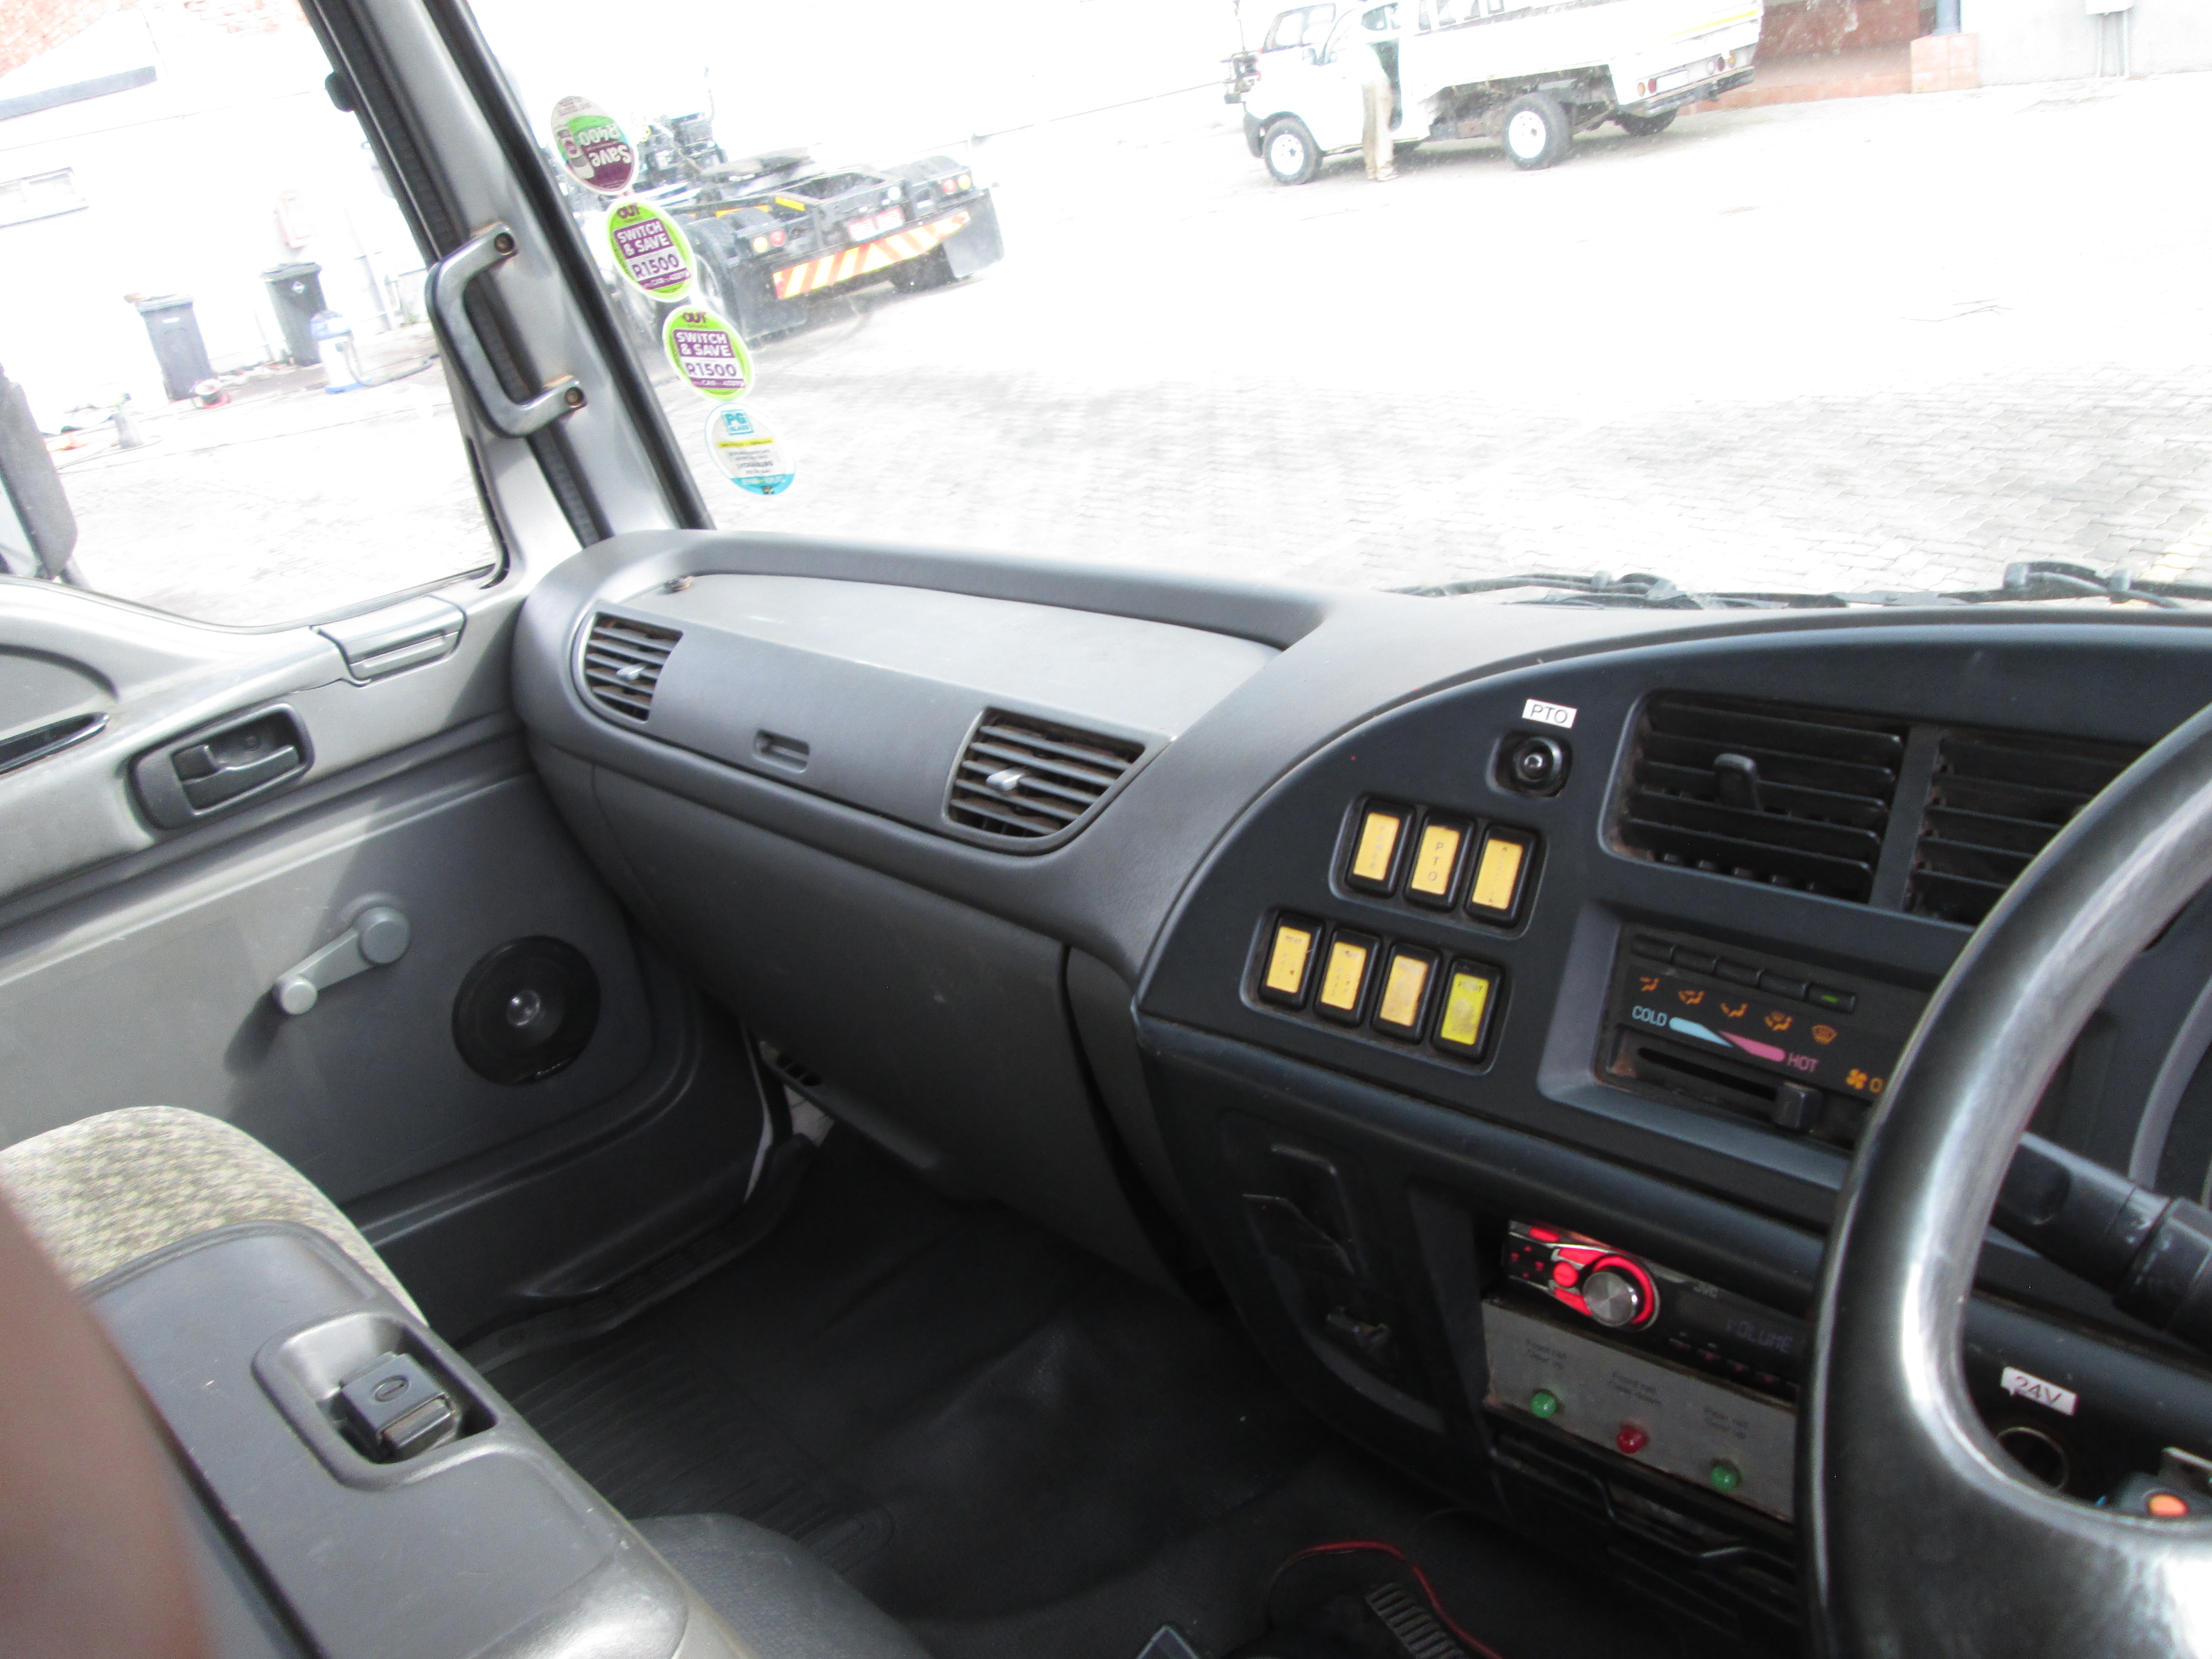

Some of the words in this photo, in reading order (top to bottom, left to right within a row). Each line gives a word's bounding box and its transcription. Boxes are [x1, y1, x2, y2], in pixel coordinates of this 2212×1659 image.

[578, 122, 621, 146] R400
[588, 144, 631, 167] Save
[616, 221, 664, 243] SWITCH
[624, 243, 636, 256] &
[634, 232, 671, 253] SAVE
[631, 254, 679, 278] R1500
[676, 332, 728, 345] SWITCH
[680, 343, 692, 355] &
[693, 344, 732, 357] SAVE
[685, 362, 736, 377] R1500
[726, 413, 747, 425] PG
[1530, 703, 1568, 724] PTO
[1427, 842, 1444, 882] PTO
[1632, 1005, 1668, 1027] COLD
[1787, 1052, 1819, 1073] HOT
[2014, 1375, 2063, 1405] 24V
